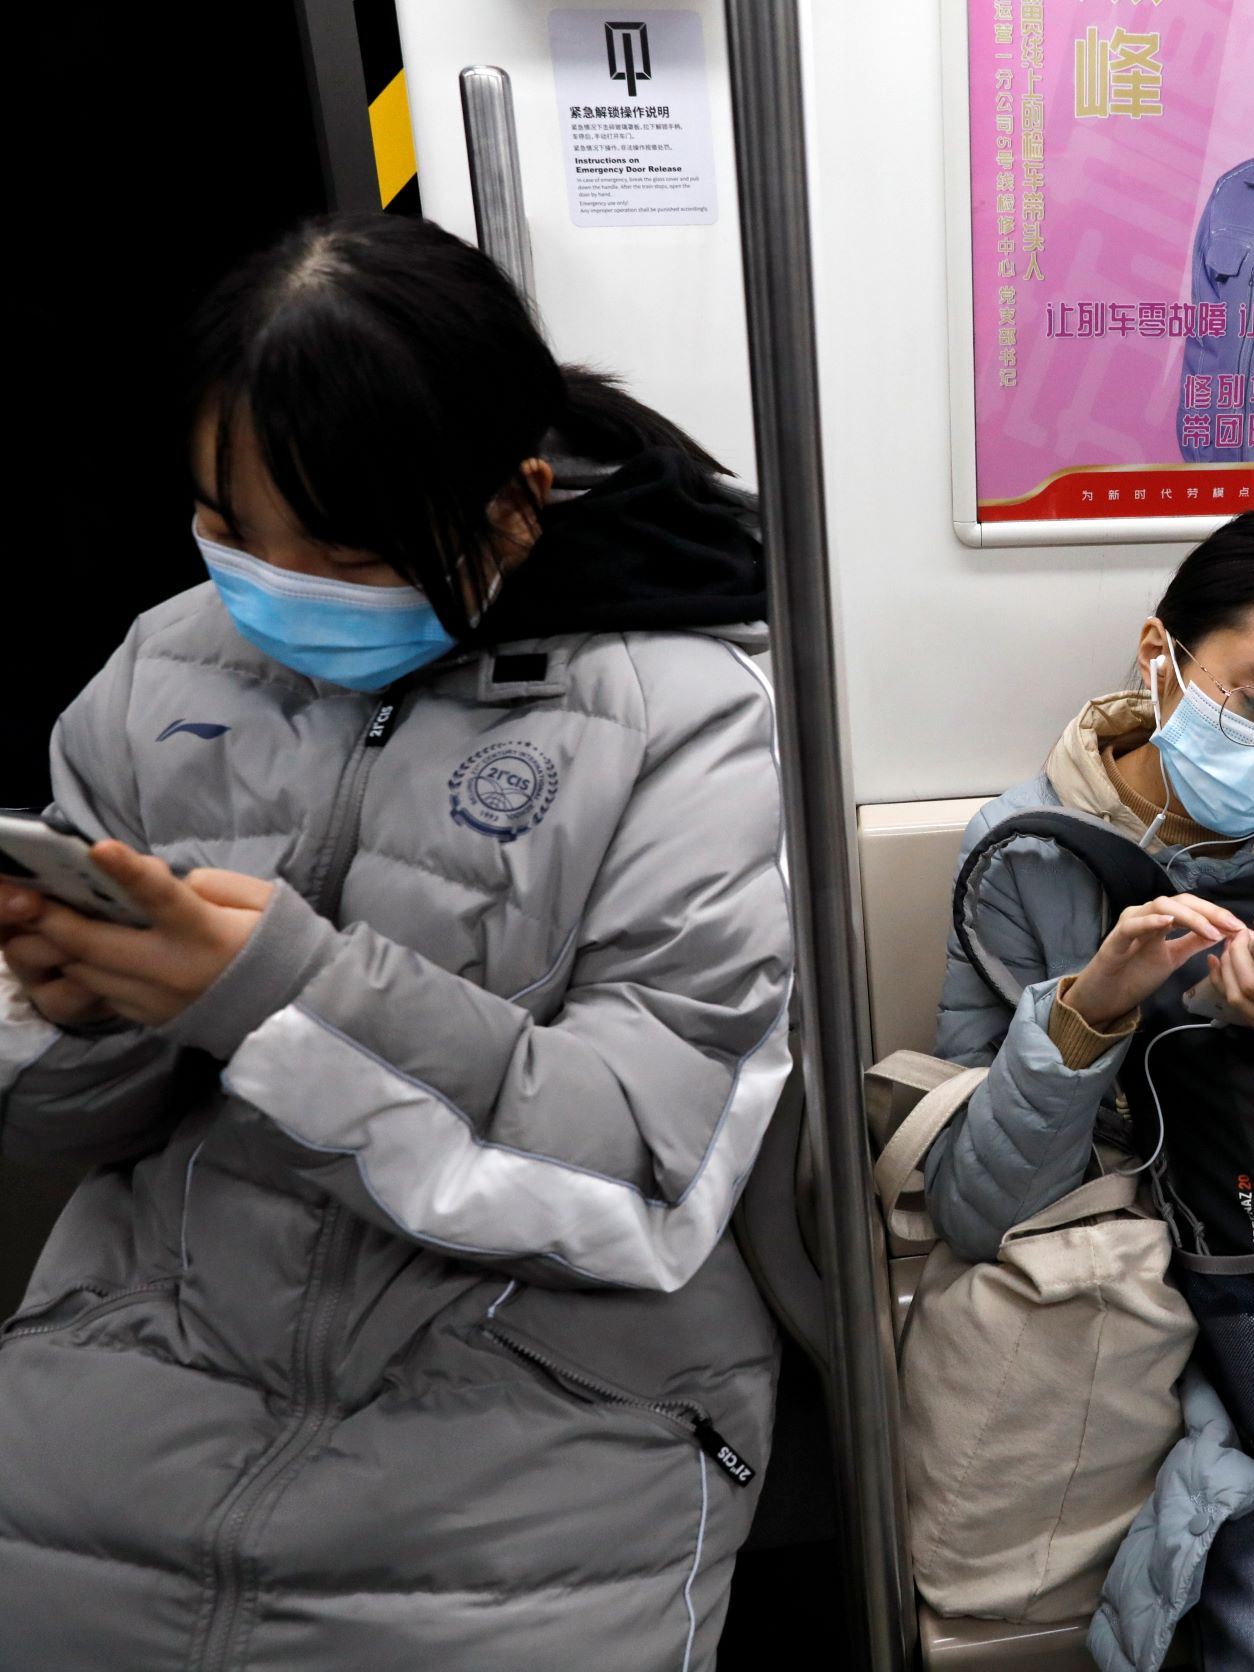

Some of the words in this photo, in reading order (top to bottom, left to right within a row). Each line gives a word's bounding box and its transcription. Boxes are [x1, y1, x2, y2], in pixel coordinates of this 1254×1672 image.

[1075, 26, 1164, 119] 峰
[570, 106, 670, 119] 紧急解锁操作说明
[1021, 0, 1045, 281] 贯线上的检车带头人
[575, 157, 627, 165] Instructions
[576, 166, 624, 175] Emergency
[648, 165, 682, 173] Release
[1046, 302, 1228, 338] 让列车零故障
[1237, 1174, 1252, 1191] 20
